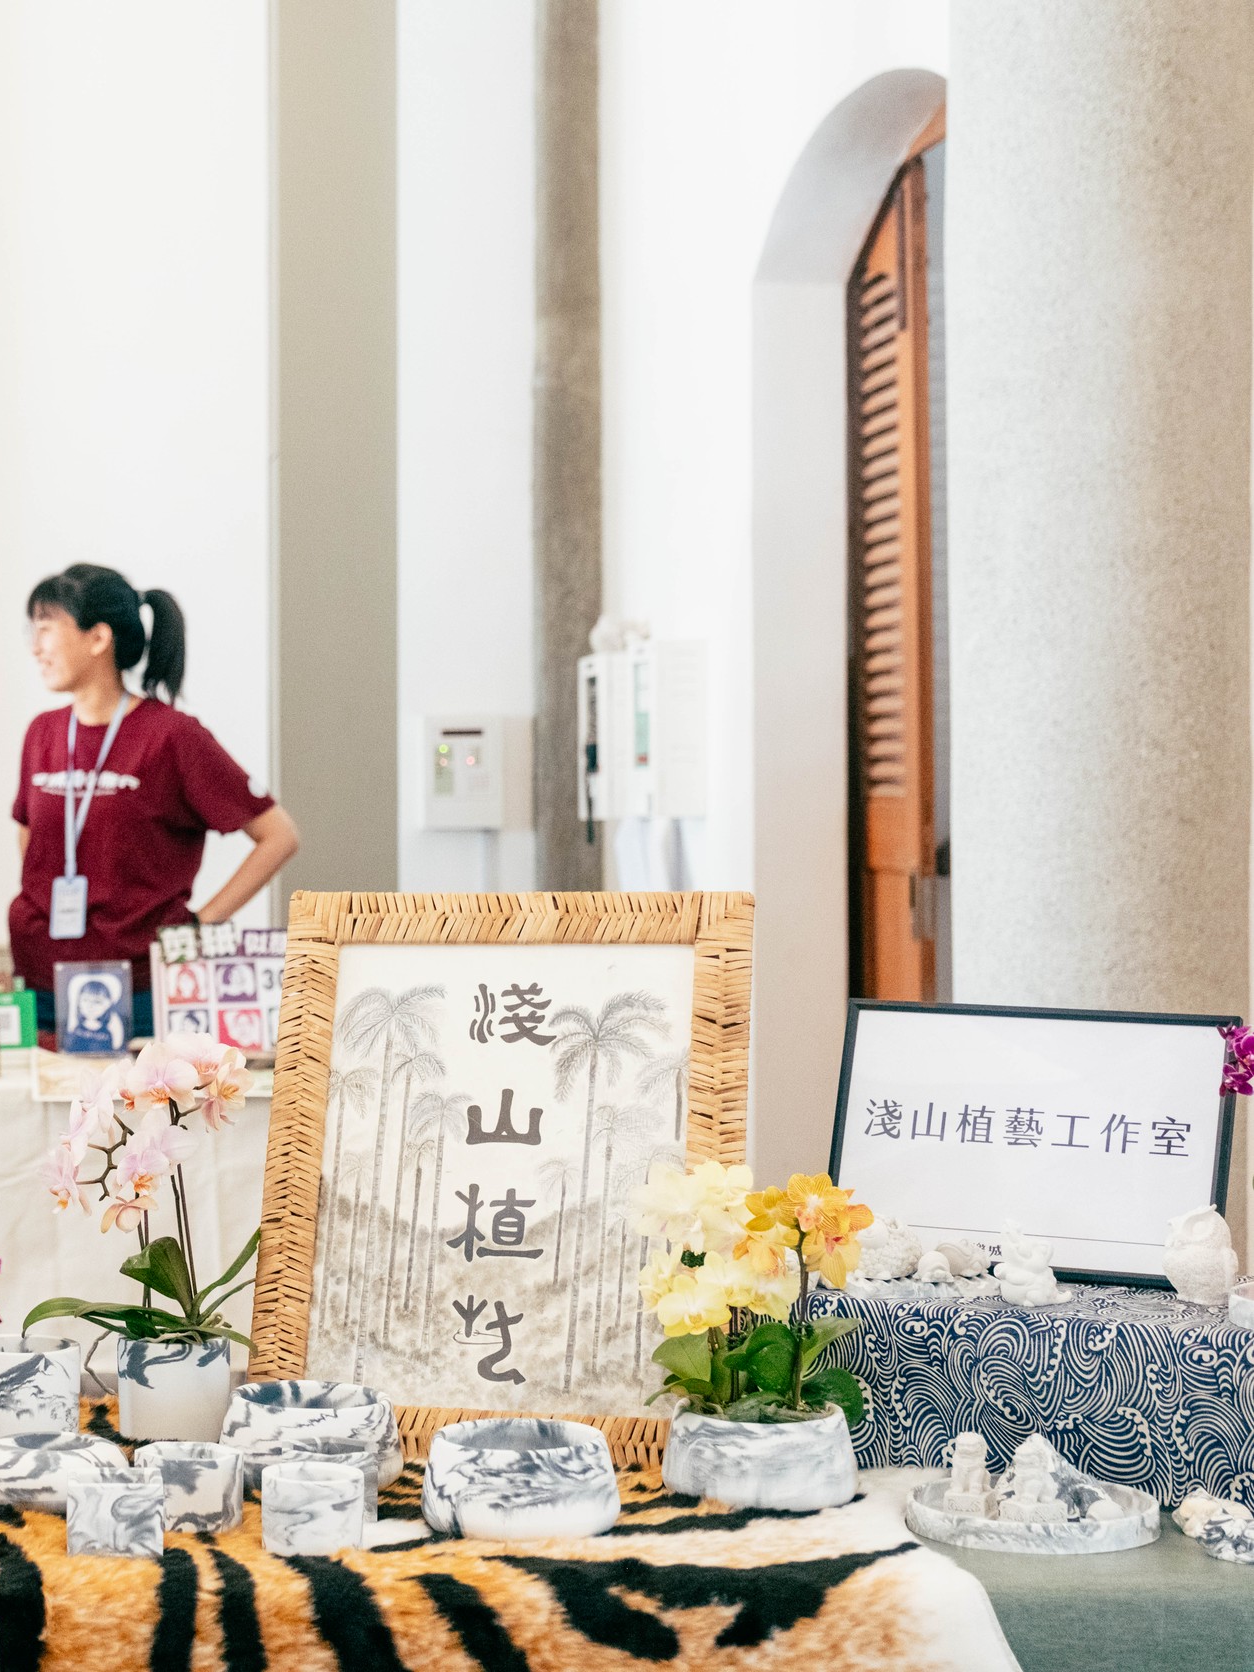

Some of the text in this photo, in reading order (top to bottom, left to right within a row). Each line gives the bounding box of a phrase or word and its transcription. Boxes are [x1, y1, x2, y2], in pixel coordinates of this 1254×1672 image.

[864, 1098, 1192, 1157] 淺山植藝工作室
